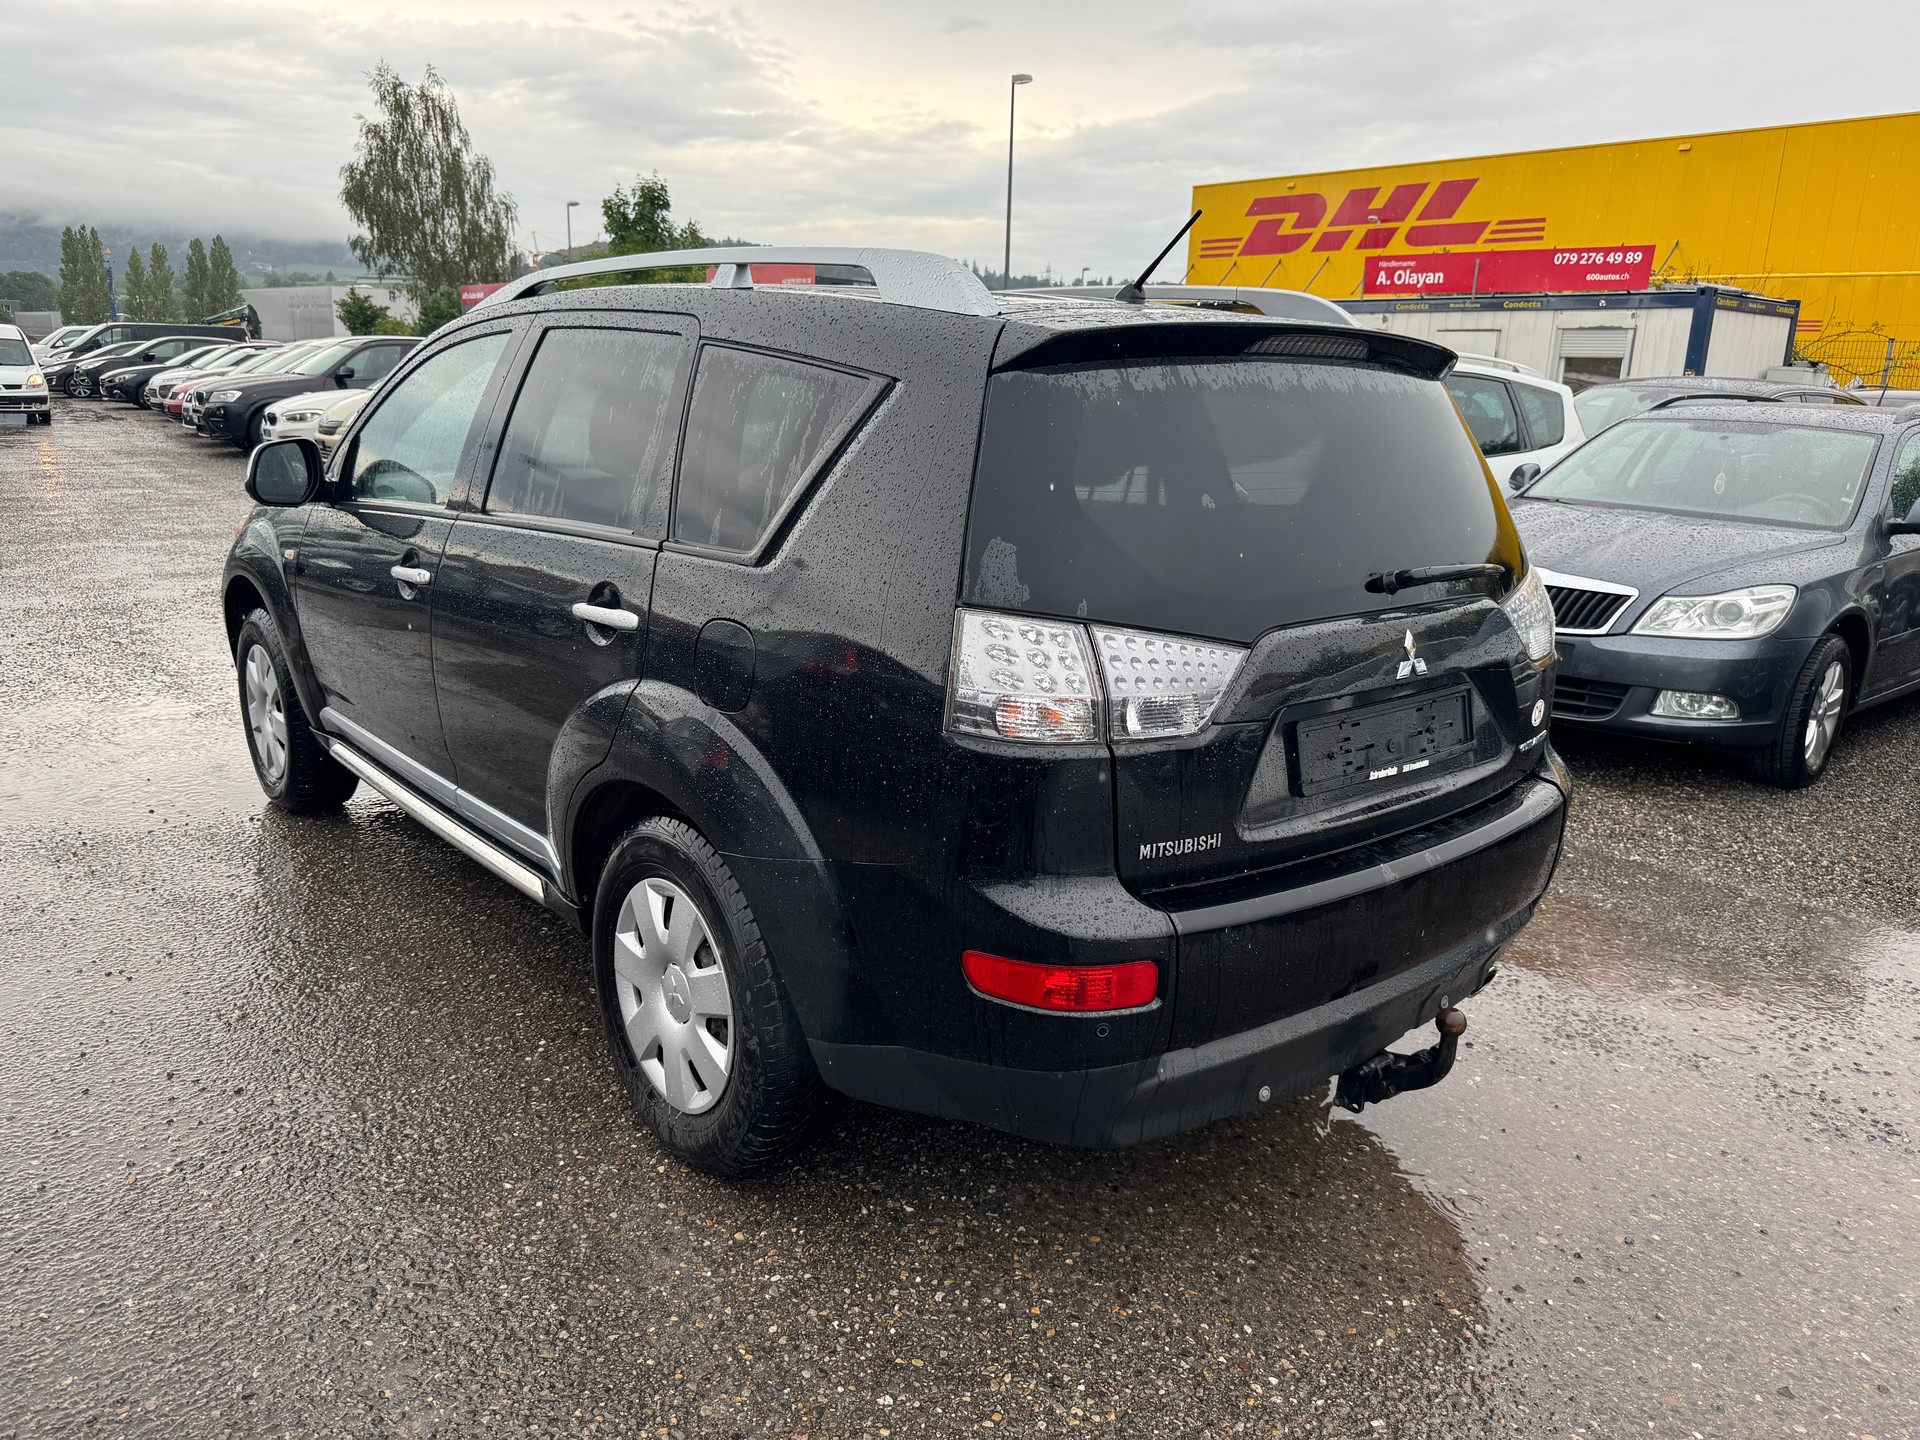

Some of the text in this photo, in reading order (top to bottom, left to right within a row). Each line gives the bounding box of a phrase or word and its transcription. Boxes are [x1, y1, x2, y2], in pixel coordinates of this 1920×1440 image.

[1238, 178, 1492, 257] DHL
[1553, 251, 1643, 265] 079 276 49 89
[1378, 260, 1417, 268] Händlername:
[1376, 269, 1444, 288] A. Olayan
[1585, 272, 1630, 281] 600autos.ch
[1395, 303, 1429, 311] Condecta
[1503, 300, 1541, 309] Condecta
[1139, 833, 1221, 860] MITSUBISHI
